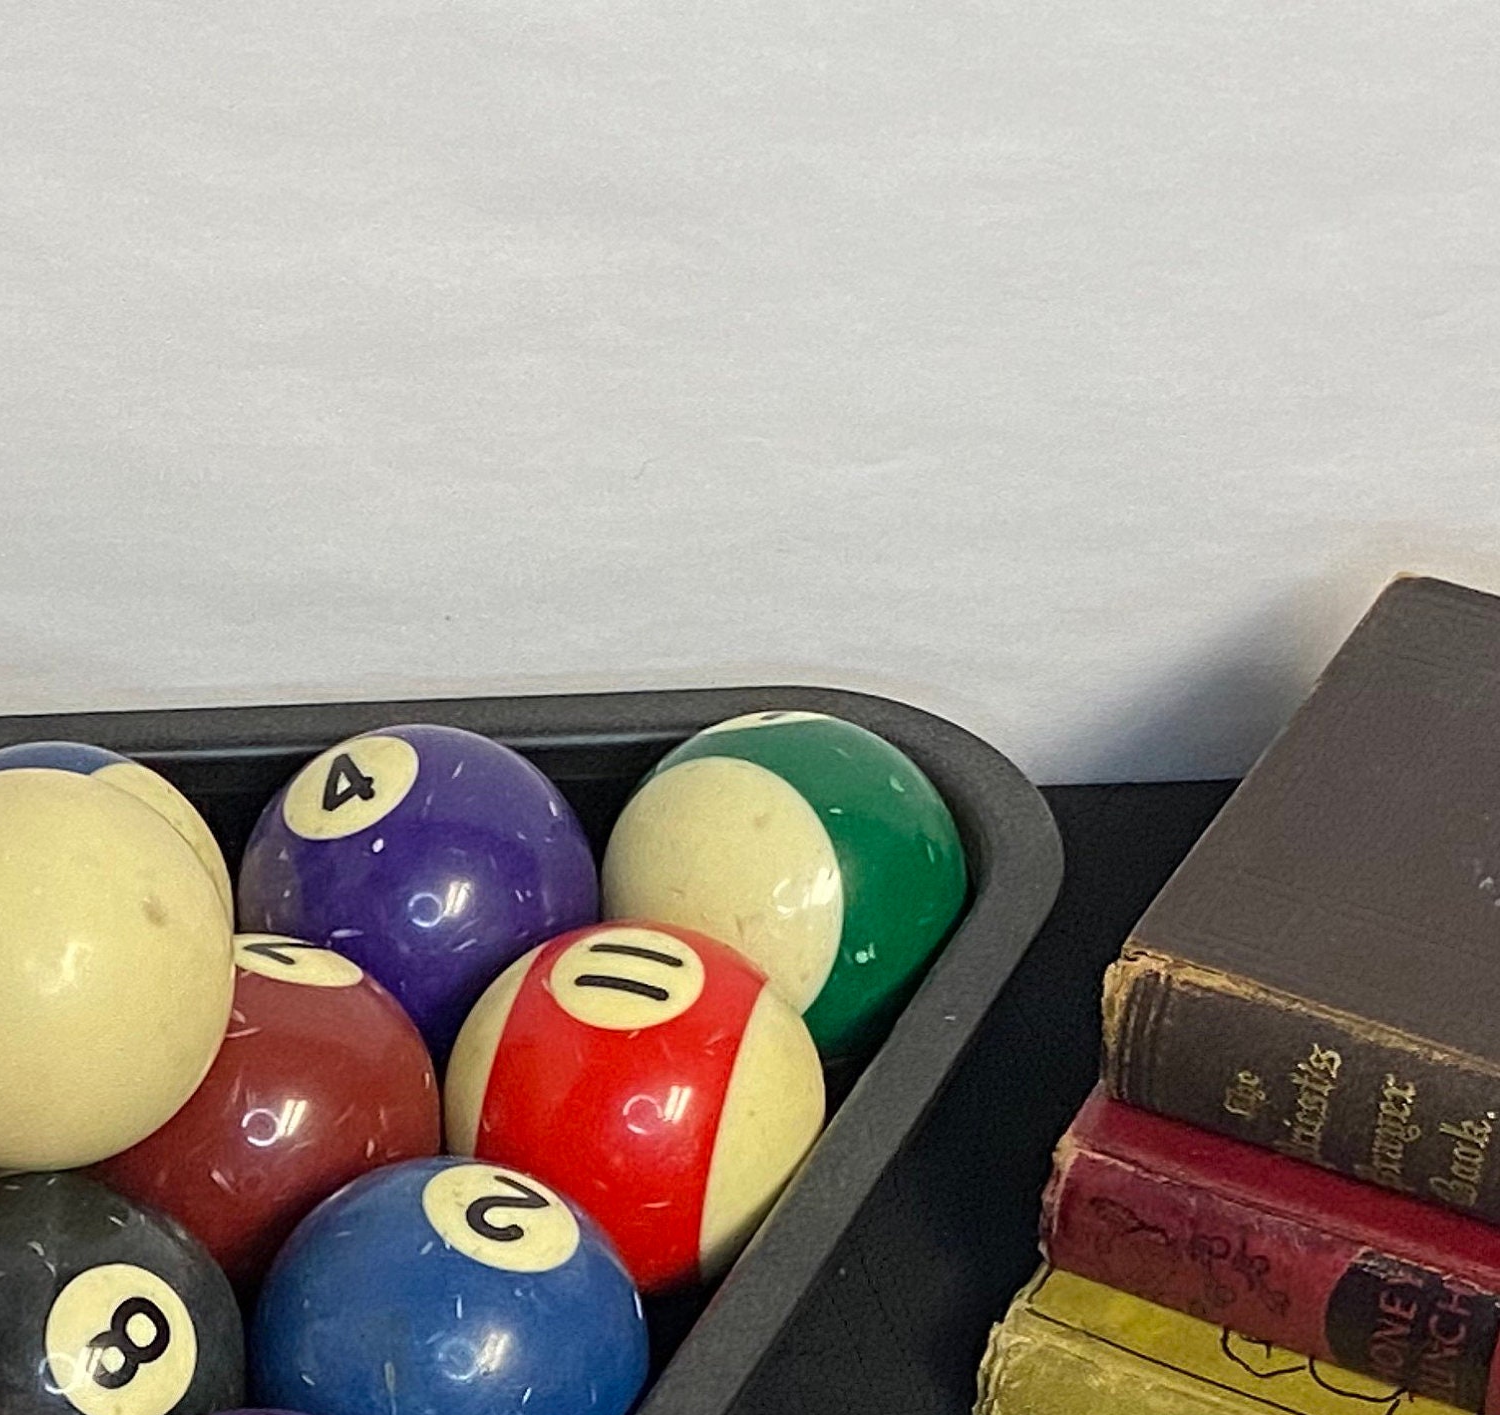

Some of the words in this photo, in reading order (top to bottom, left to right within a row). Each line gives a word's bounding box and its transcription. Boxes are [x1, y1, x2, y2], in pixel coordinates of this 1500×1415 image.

[322, 753, 375, 811] 4
[574, 943, 684, 1002] 11
[465, 1175, 551, 1241] 2
[87, 1296, 171, 1389] 8
